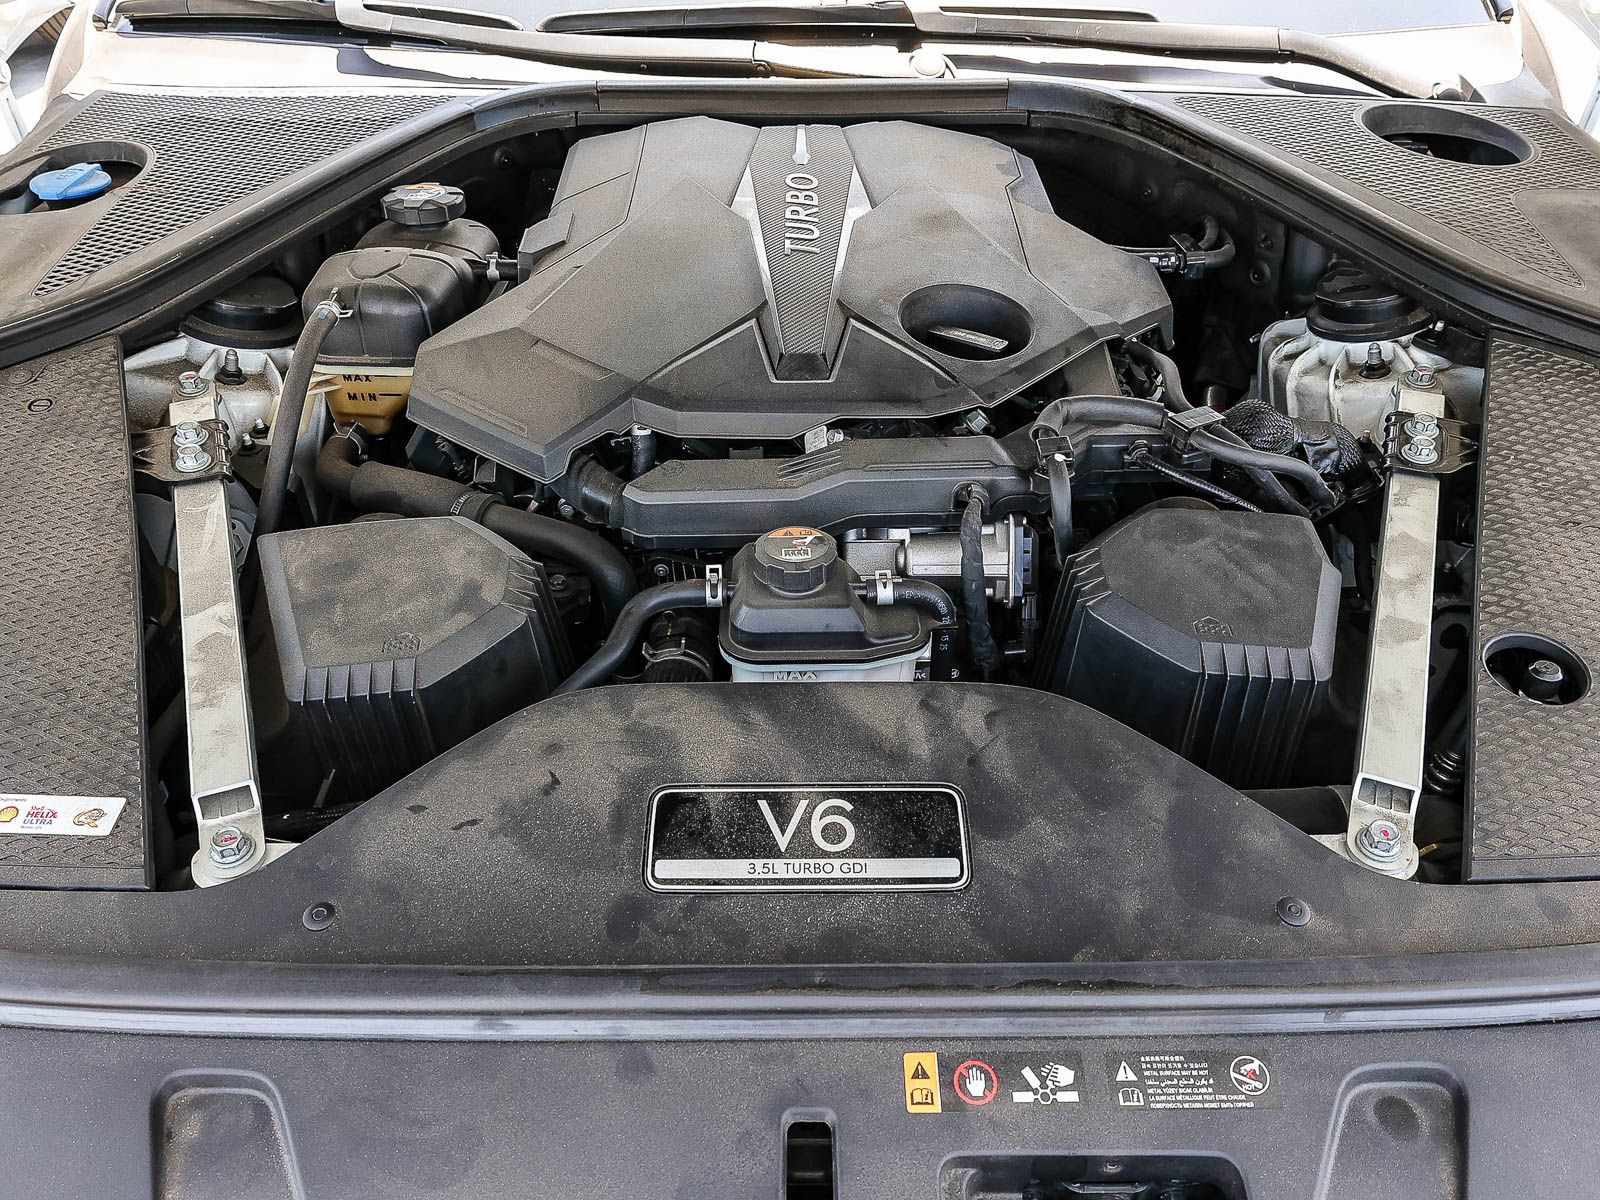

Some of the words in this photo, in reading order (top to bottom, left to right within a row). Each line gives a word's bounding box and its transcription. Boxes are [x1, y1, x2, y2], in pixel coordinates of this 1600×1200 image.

[784, 172, 821, 256] TURBO
[342, 374, 373, 382] MAX
[347, 392, 377, 402] MIN
[26, 808, 59, 819] HELIX
[757, 798, 856, 853] V6
[747, 862, 779, 875] 3.5L
[783, 862, 834, 875] TURBO
[838, 862, 868, 875] GDI
